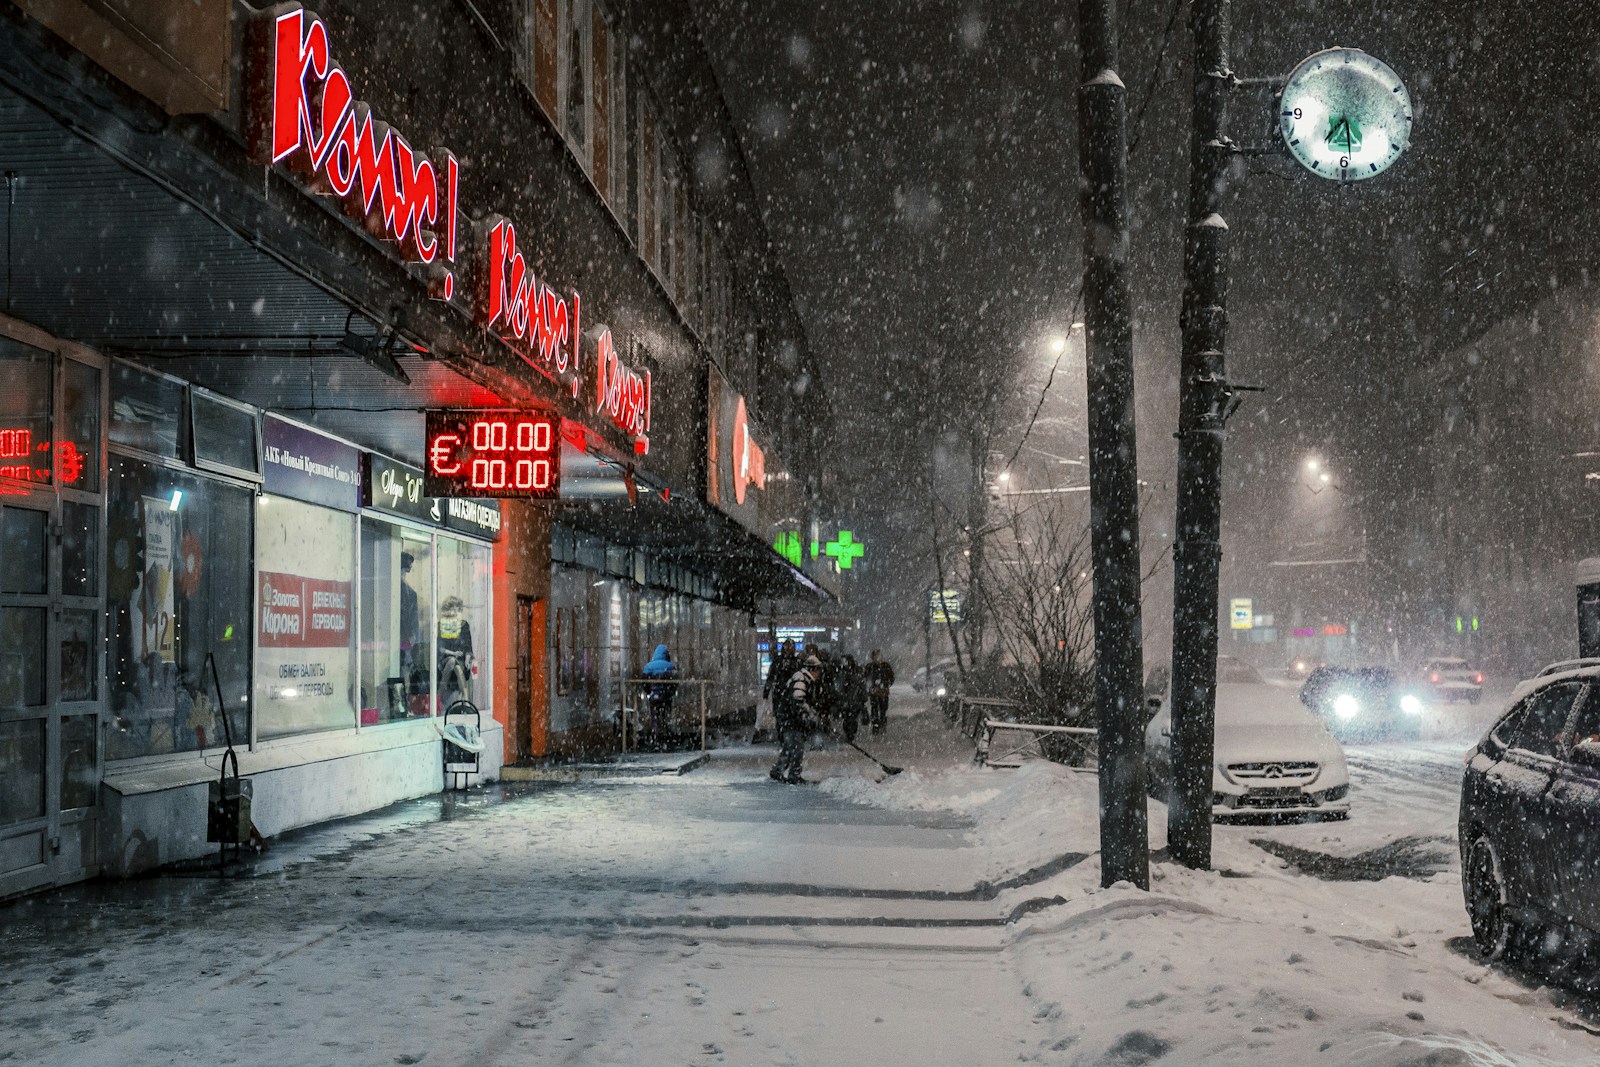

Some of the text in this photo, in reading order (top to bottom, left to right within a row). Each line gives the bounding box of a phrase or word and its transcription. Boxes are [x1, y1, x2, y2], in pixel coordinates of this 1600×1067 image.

[1293, 108, 1303, 120] 9
[1339, 155, 1349, 168] 6
[473, 422, 550, 451] 00.00
[264, 446, 280, 464] АКБ
[430, 435, 461, 473] €
[472, 459, 549, 488] 00.00
[448, 498, 501, 532] МАГАЗИН ОДЕЖДЫ
[271, 588, 299, 608] Золотая
[262, 605, 299, 640] Корона
